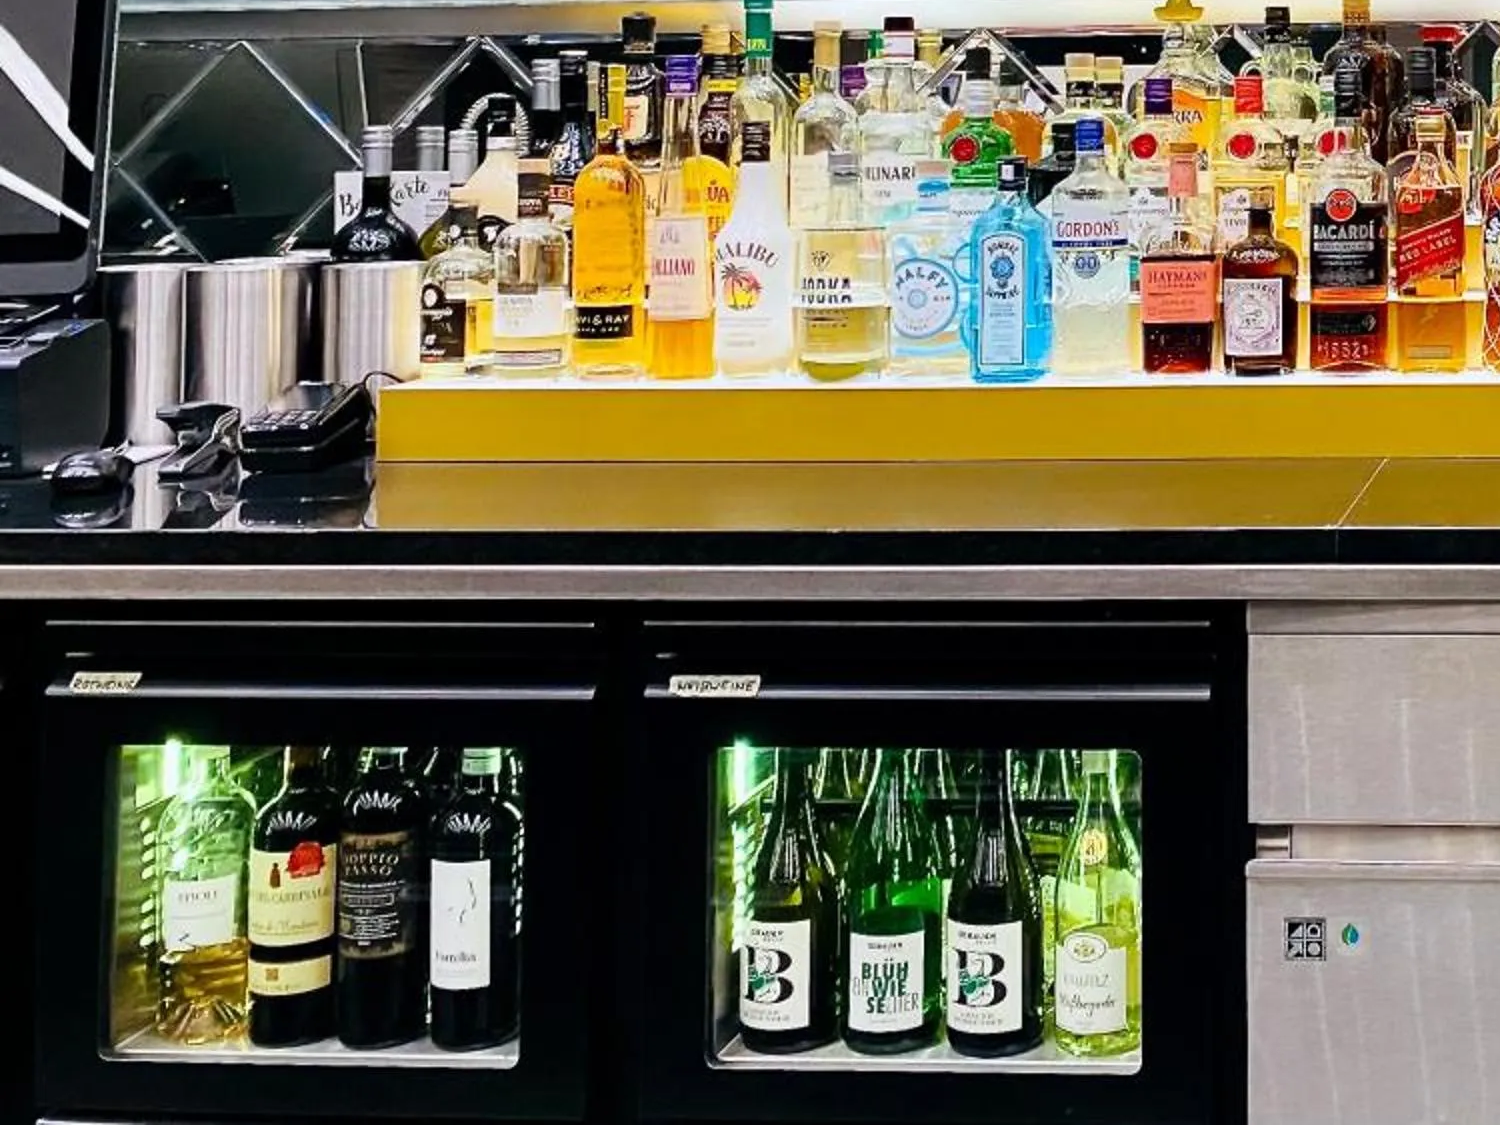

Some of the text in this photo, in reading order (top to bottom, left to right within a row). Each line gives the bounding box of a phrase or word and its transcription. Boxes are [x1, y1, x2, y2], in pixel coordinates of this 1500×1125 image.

[1056, 218, 1120, 238] GORDON'S
[1313, 219, 1375, 240] BACARDÍ
[1399, 237, 1458, 263] RED LABEL
[861, 957, 909, 981] BLÜH
